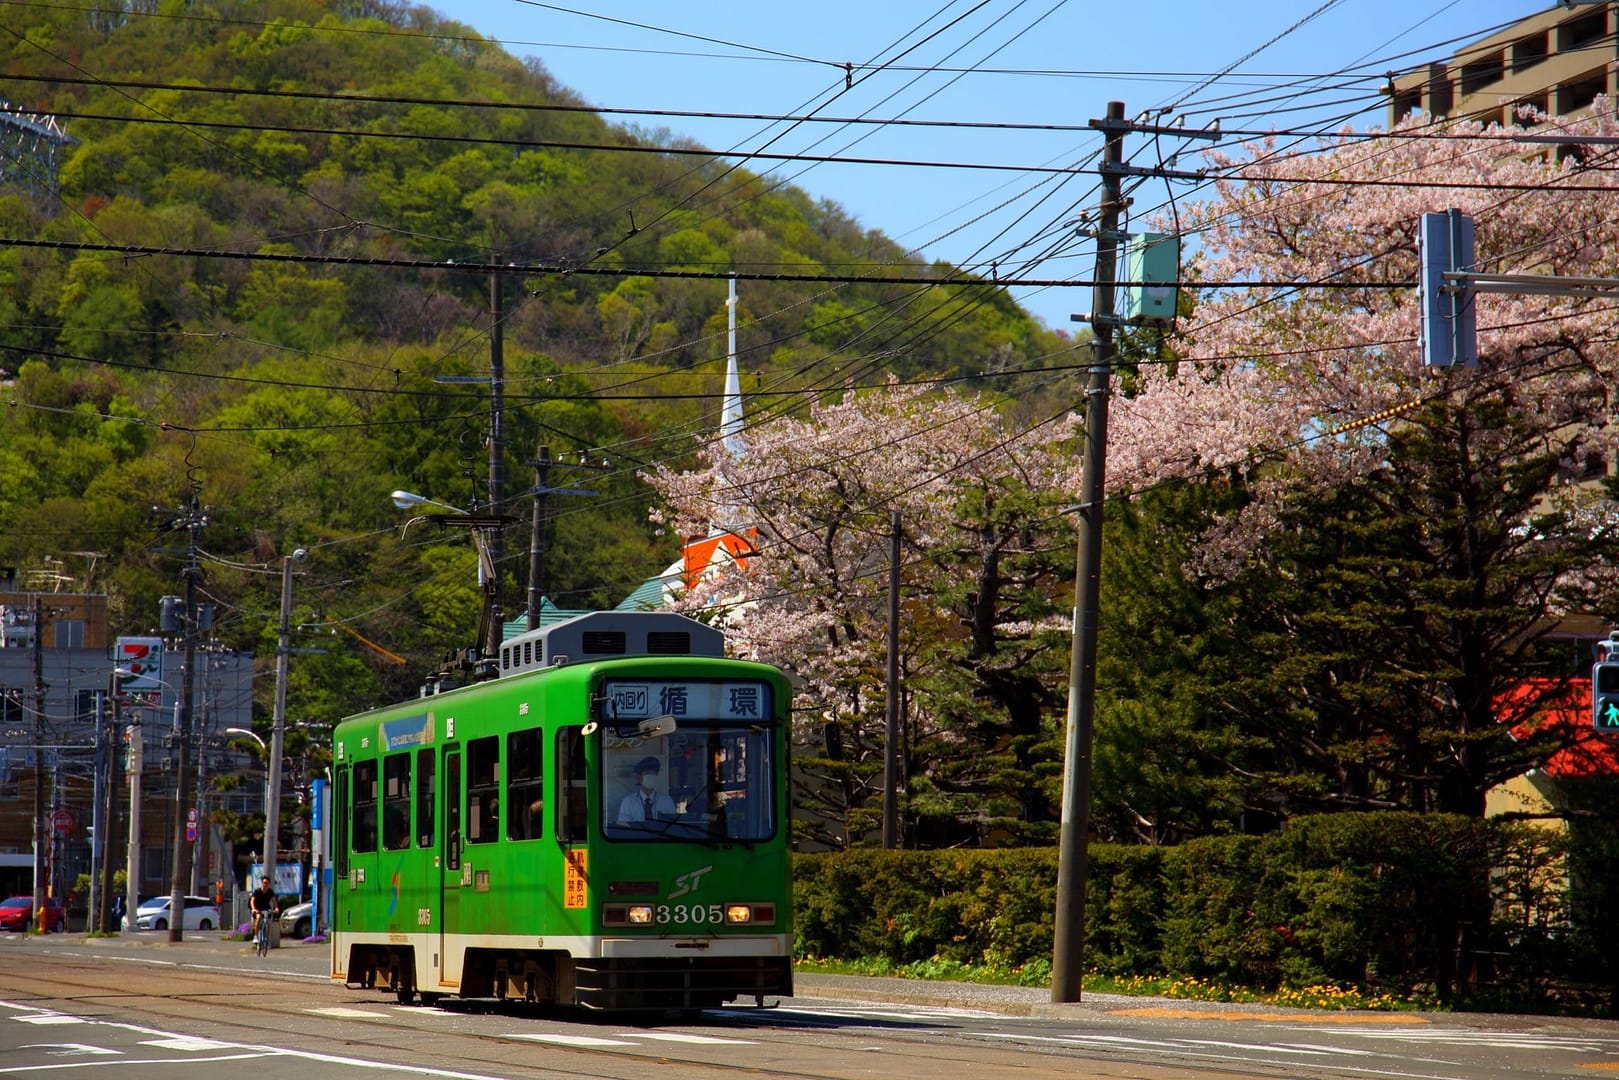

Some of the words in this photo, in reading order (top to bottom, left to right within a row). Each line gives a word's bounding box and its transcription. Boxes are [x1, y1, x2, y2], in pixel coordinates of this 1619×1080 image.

[616, 691, 647, 710] 内回り
[659, 686, 758, 716] 循環
[668, 865, 712, 900] ST
[656, 904, 723, 924] 3305
